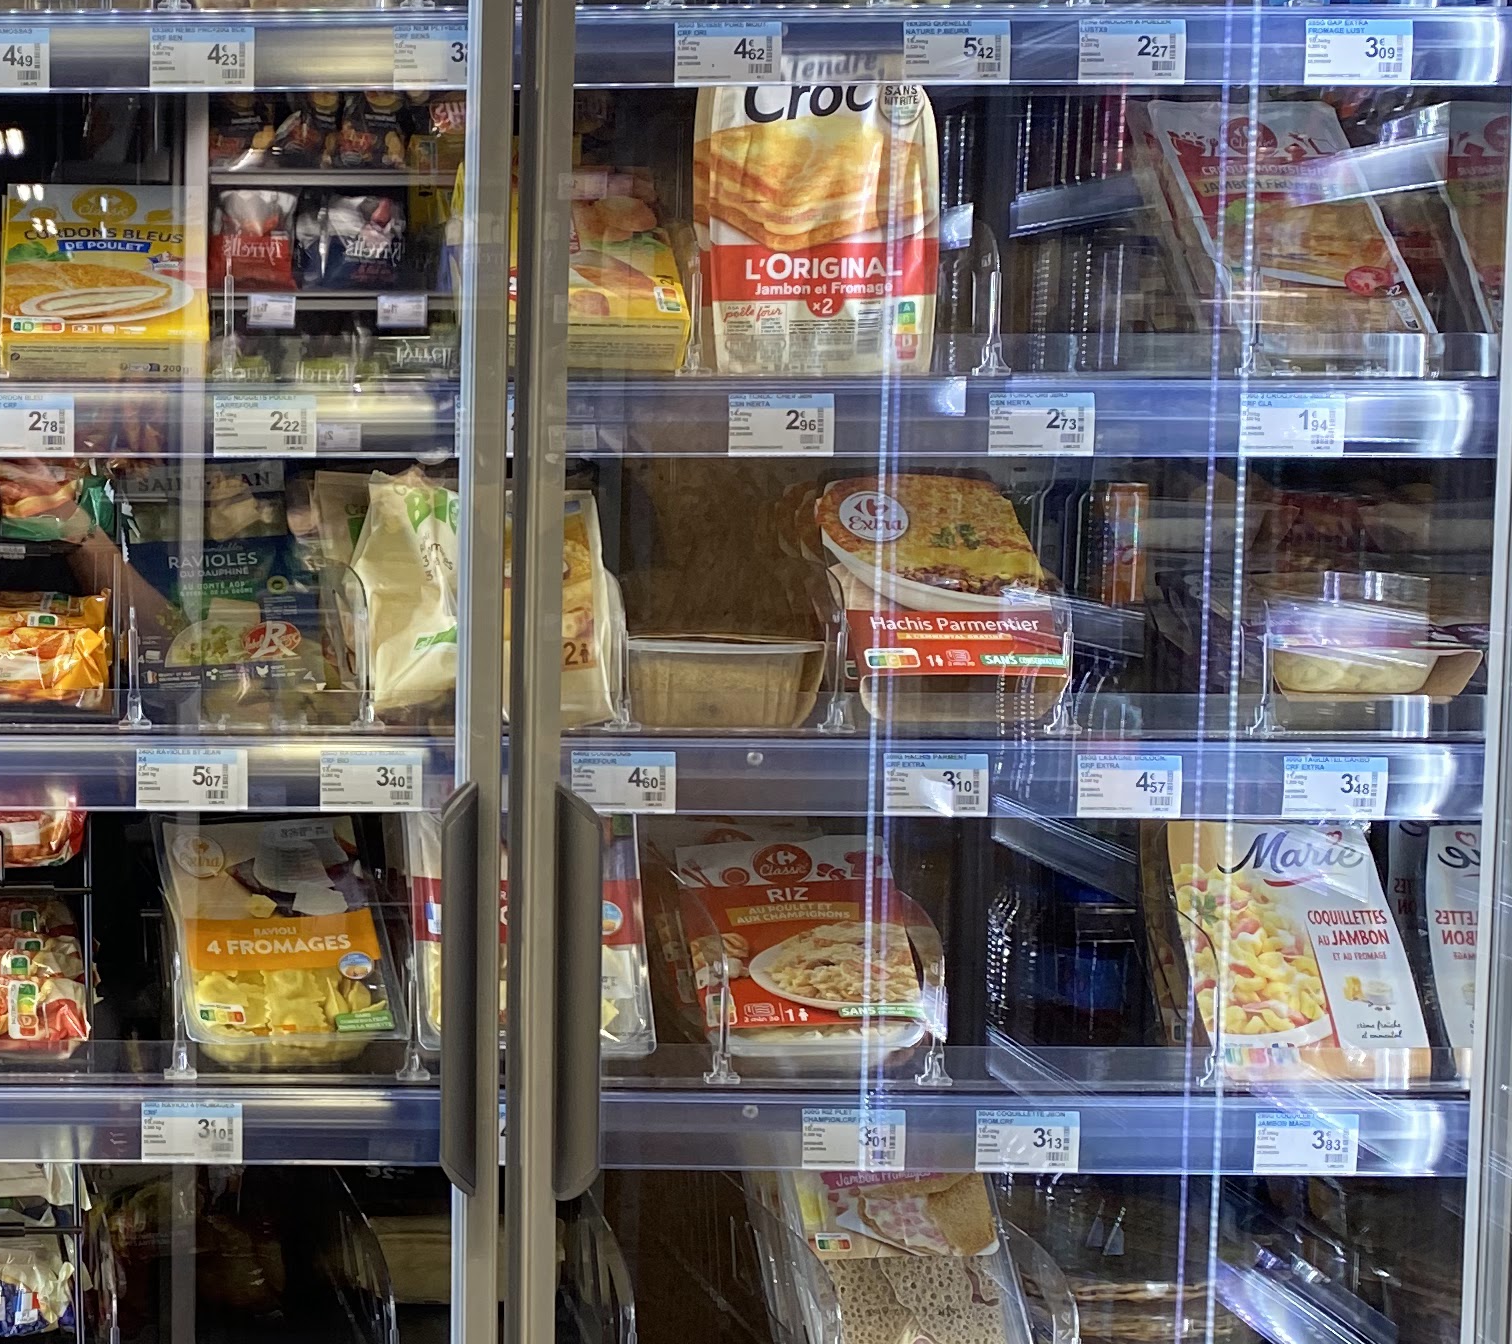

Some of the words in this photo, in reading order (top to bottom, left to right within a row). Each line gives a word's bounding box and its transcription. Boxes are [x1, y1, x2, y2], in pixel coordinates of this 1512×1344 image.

[884, 86, 918, 96] SANS
[123, 228, 184, 243] BLEUS
[65, 241, 83, 251] DE
[87, 241, 144, 252] POULET
[745, 254, 903, 280] L'ORIGINAL
[755, 282, 811, 296] Jambon
[814, 284, 827, 296] et
[831, 282, 893, 298] Fromage
[812, 298, 834, 314] x2
[745, 400, 771, 408] HERTA
[849, 515, 906, 532] Extra
[168, 552, 258, 569] RAVIOLES
[180, 569, 194, 578] DU
[197, 565, 249, 577] DAUPHINÉ
[870, 616, 933, 632] Hachis
[938, 616, 1039, 632] Parmentier
[563, 641, 576, 666] 2
[985, 655, 1017, 665] SANS
[1216, 830, 1364, 875] Marie
[766, 887, 809, 903] RIZ
[737, 914, 761, 924] AUX
[763, 910, 851, 922] CHAMPIGNONS
[749, 907, 765, 916] AU
[768, 903, 813, 915] POULET
[817, 903, 833, 911] ET
[1307, 909, 1388, 927] COQUILLETTES
[253, 926, 297, 937] RAVIOLI
[1318, 935, 1330, 946] AU
[1331, 929, 1390, 946] JAMBON
[206, 938, 221, 955] 4
[226, 934, 352, 956] FROMAGES
[1354, 951, 1387, 960] FROMAGE
[841, 1006, 877, 1016] SANS
